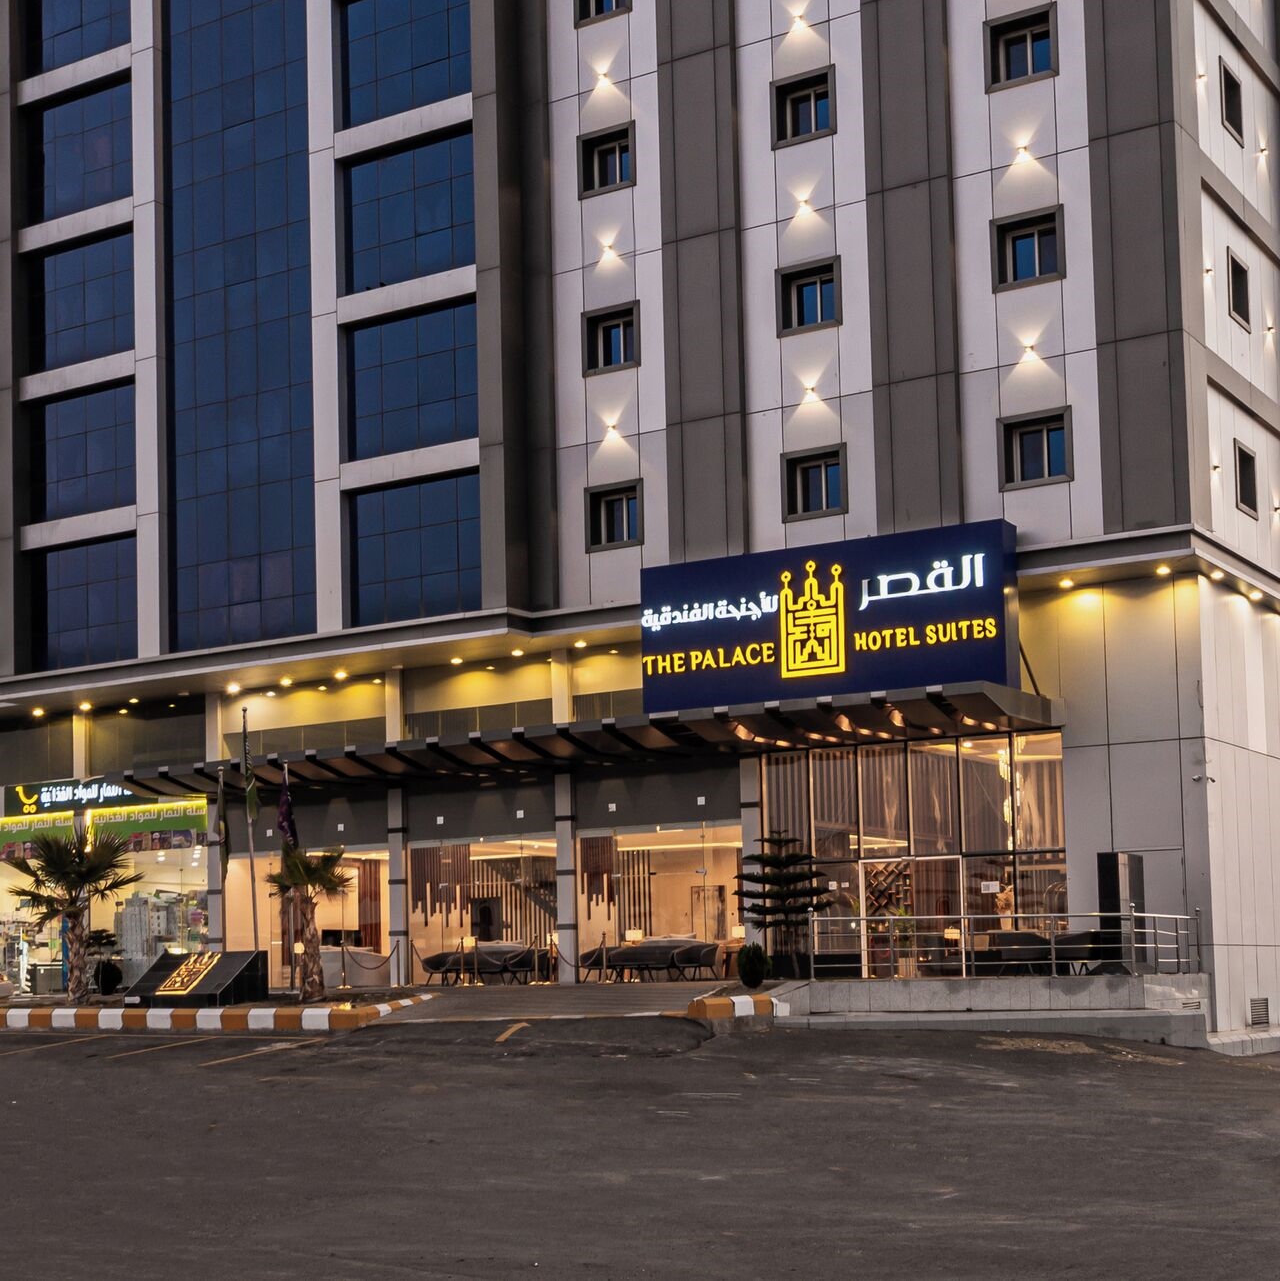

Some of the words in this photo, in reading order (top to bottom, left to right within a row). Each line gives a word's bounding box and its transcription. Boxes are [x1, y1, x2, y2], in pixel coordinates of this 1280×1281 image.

[858, 553, 985, 611] القصر
[641, 603, 714, 631] الفندقية
[715, 591, 779, 621] للأجنحة
[853, 626, 921, 651] HOTEL
[925, 617, 997, 645] SUITES
[642, 652, 686, 676] THE
[689, 642, 776, 672] PALACE
